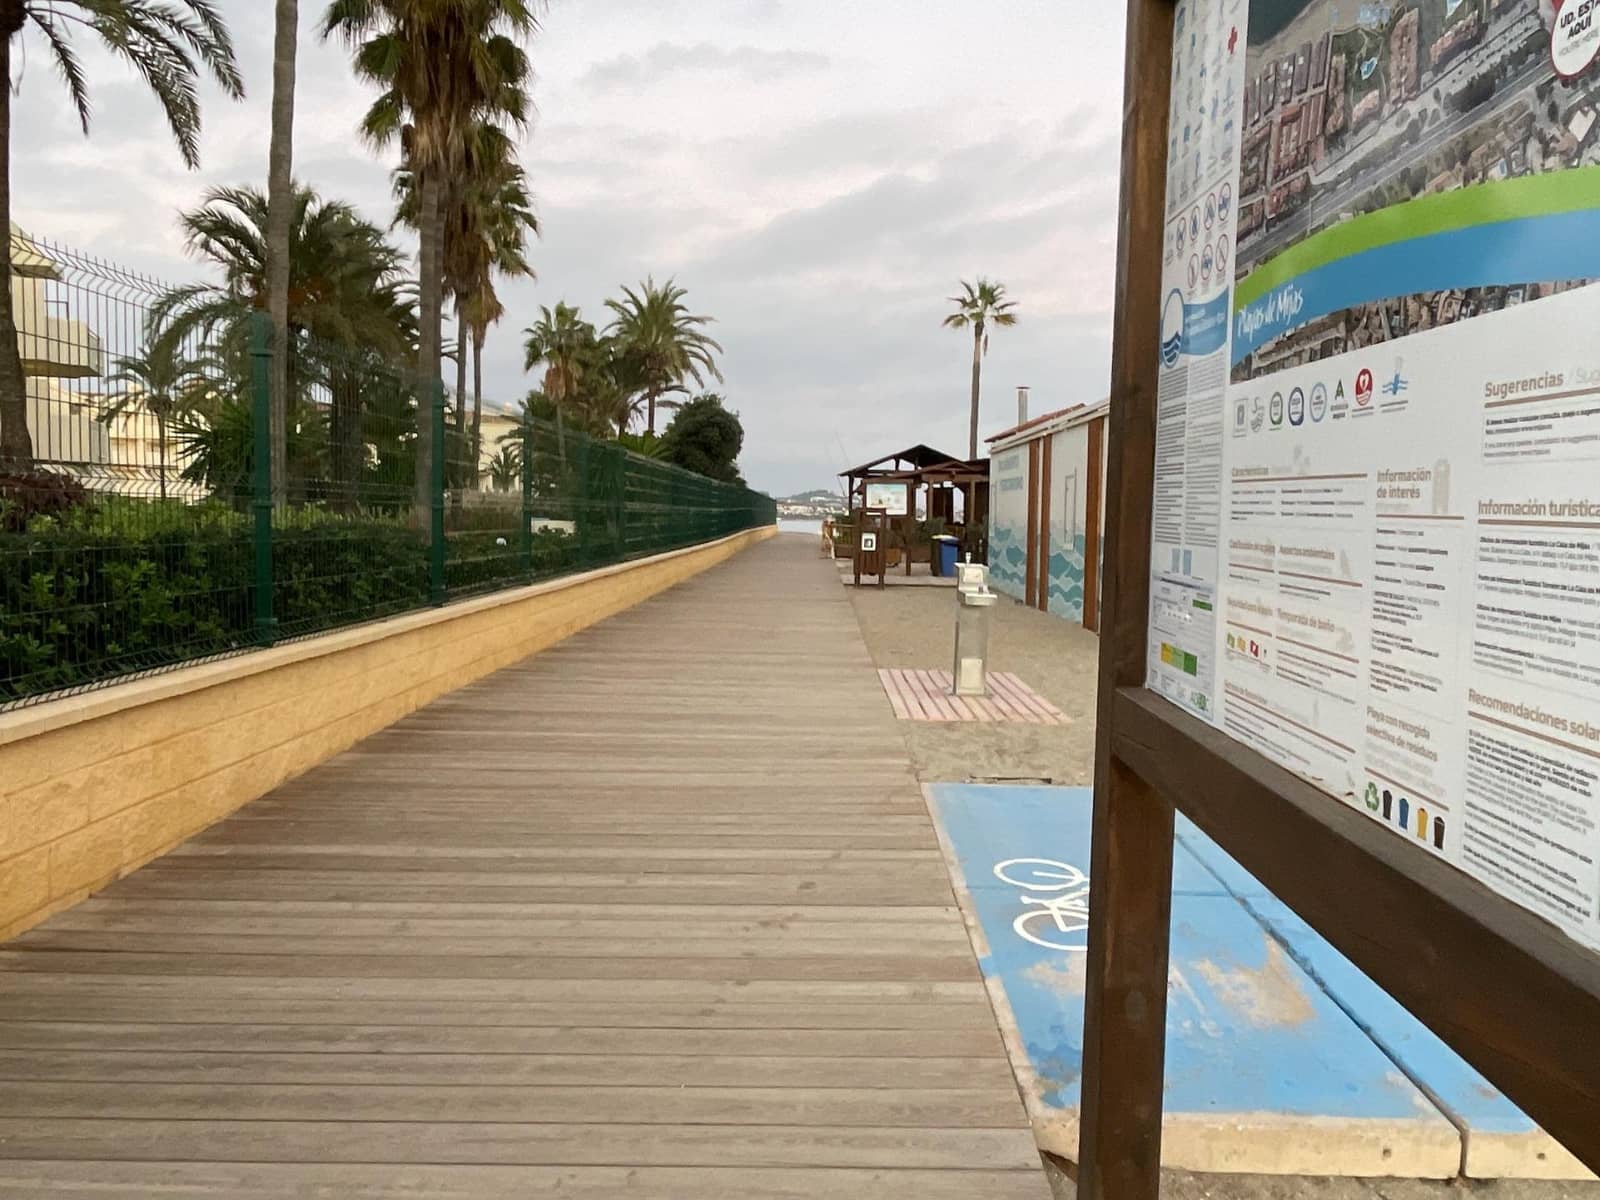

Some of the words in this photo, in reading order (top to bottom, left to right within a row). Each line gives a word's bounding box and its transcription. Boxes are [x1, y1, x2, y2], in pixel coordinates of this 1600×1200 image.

[1561, 11, 1576, 28] UD.
[1276, 283, 1304, 326] Mijas
[1484, 370, 1564, 399] Sugerencias
[1377, 467, 1432, 482] Información
[1376, 485, 1387, 498] de
[1389, 483, 1421, 498] interés
[1478, 498, 1546, 516] Información
[1468, 688, 1568, 731] Recomendaciones
